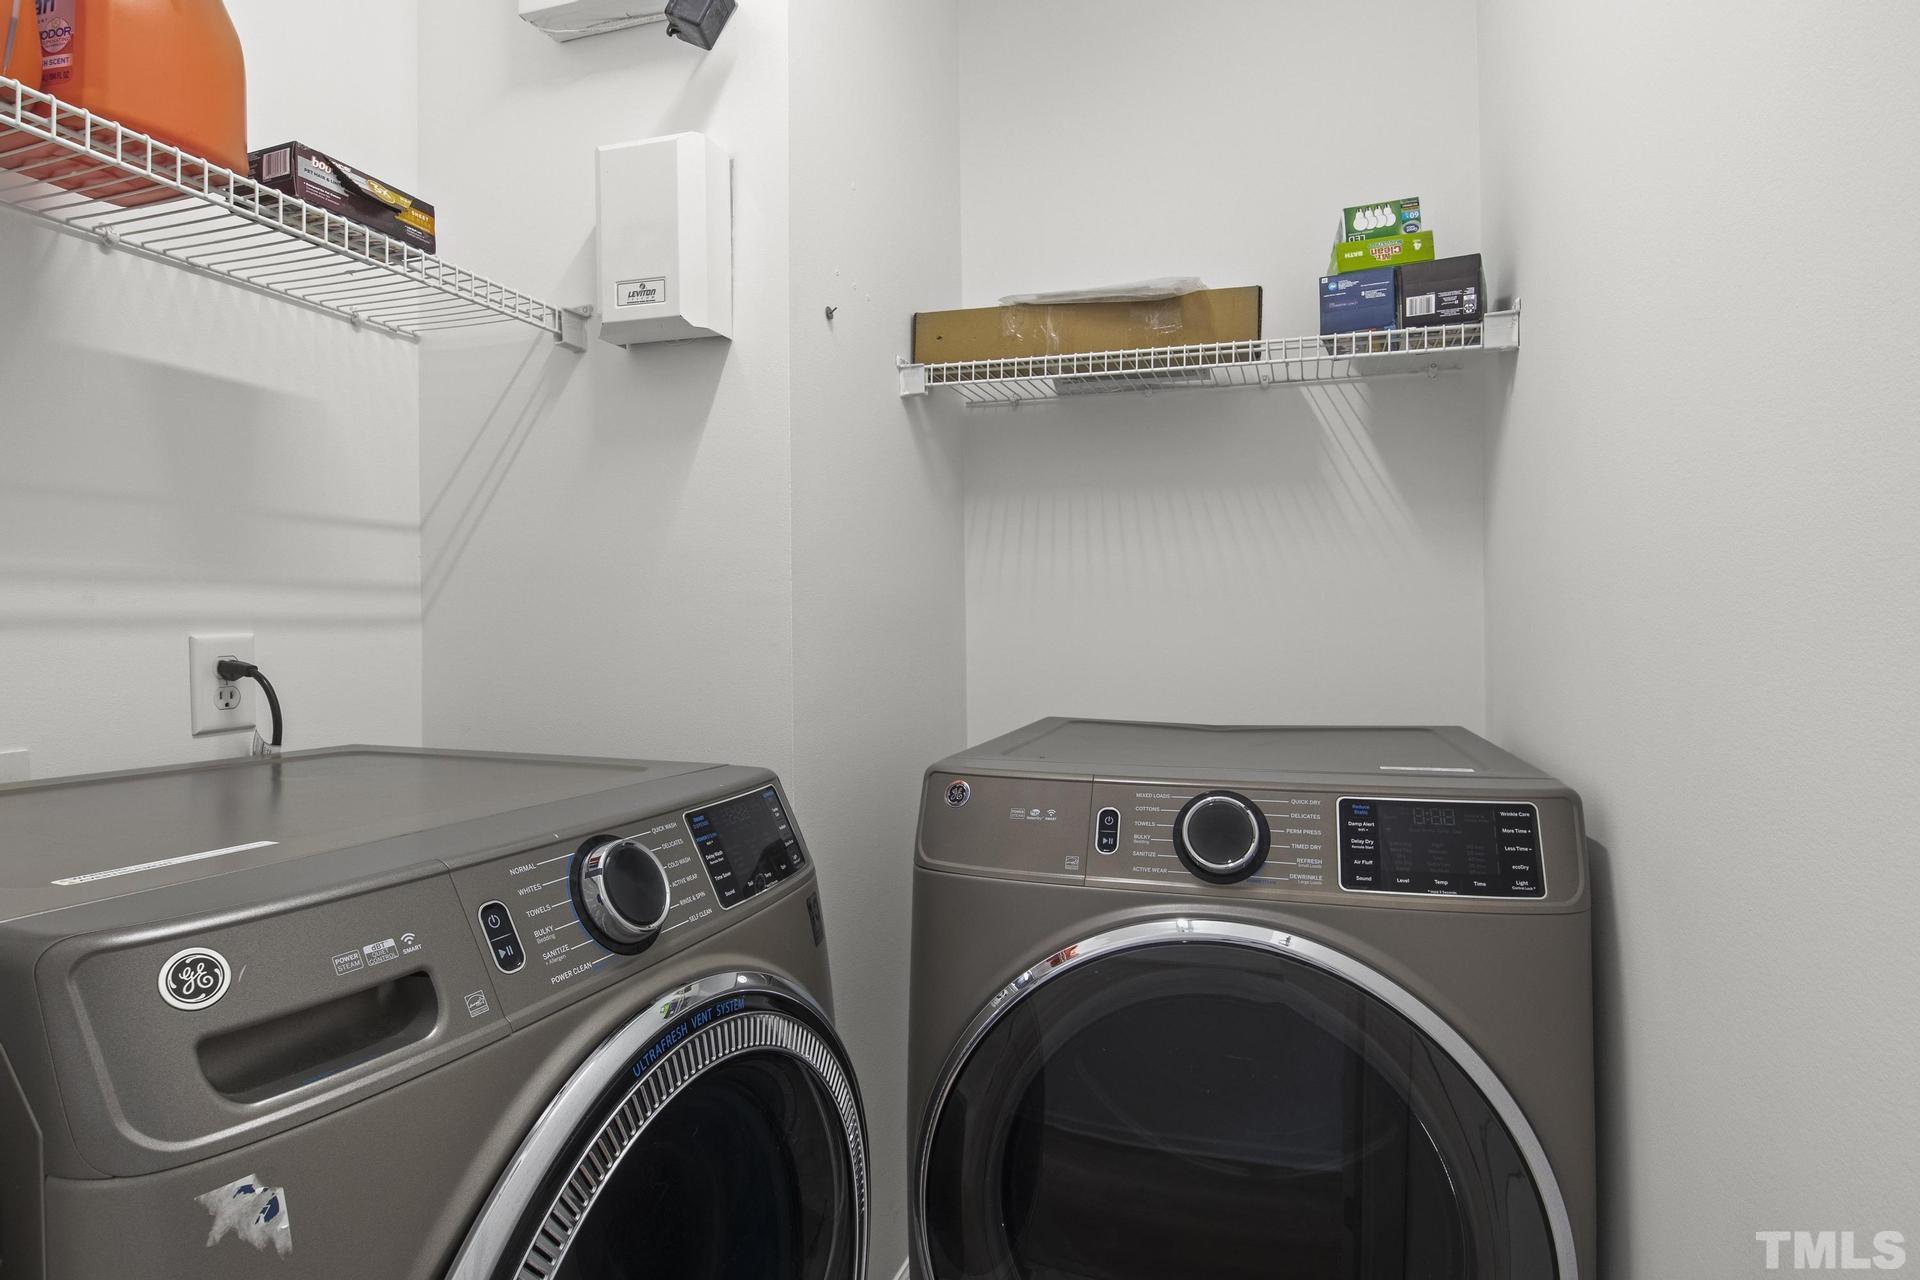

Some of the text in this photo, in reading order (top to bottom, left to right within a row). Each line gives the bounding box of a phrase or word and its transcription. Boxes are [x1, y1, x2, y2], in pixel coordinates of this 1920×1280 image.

[41, 26, 72, 41] ODOR
[48, 56, 70, 66] SCENT
[1369, 245, 1403, 256] Clean
[627, 288, 657, 299] LEVITON
[664, 822, 678, 831] WASH
[661, 838, 685, 850] DELICATES
[667, 856, 692, 869] COLD WASH
[705, 852, 716, 861] Delay
[509, 863, 537, 876] NORMAL
[671, 873, 698, 888] ACTIVE WEAR
[714, 874, 723, 882] Time
[1289, 873, 1323, 881] DEWRINKLE
[517, 883, 543, 896] WHITES
[695, 891, 706, 899] SPIN
[724, 888, 736, 898] Sound
[526, 904, 552, 918] TOWELS
[688, 908, 713, 923] SELF CLEAN
[533, 925, 554, 939] BULKY
[371, 948, 390, 958] QUIET
[402, 944, 422, 955] SMART
[542, 944, 571, 961] SANITIZE
[334, 952, 359, 966] POWER
[369, 952, 397, 965] CONTROL
[337, 960, 361, 972] STEAM
[551, 961, 593, 985] POWER CLEAN
[632, 997, 745, 1078] ULTRAFRESH VENT SYSTEM
